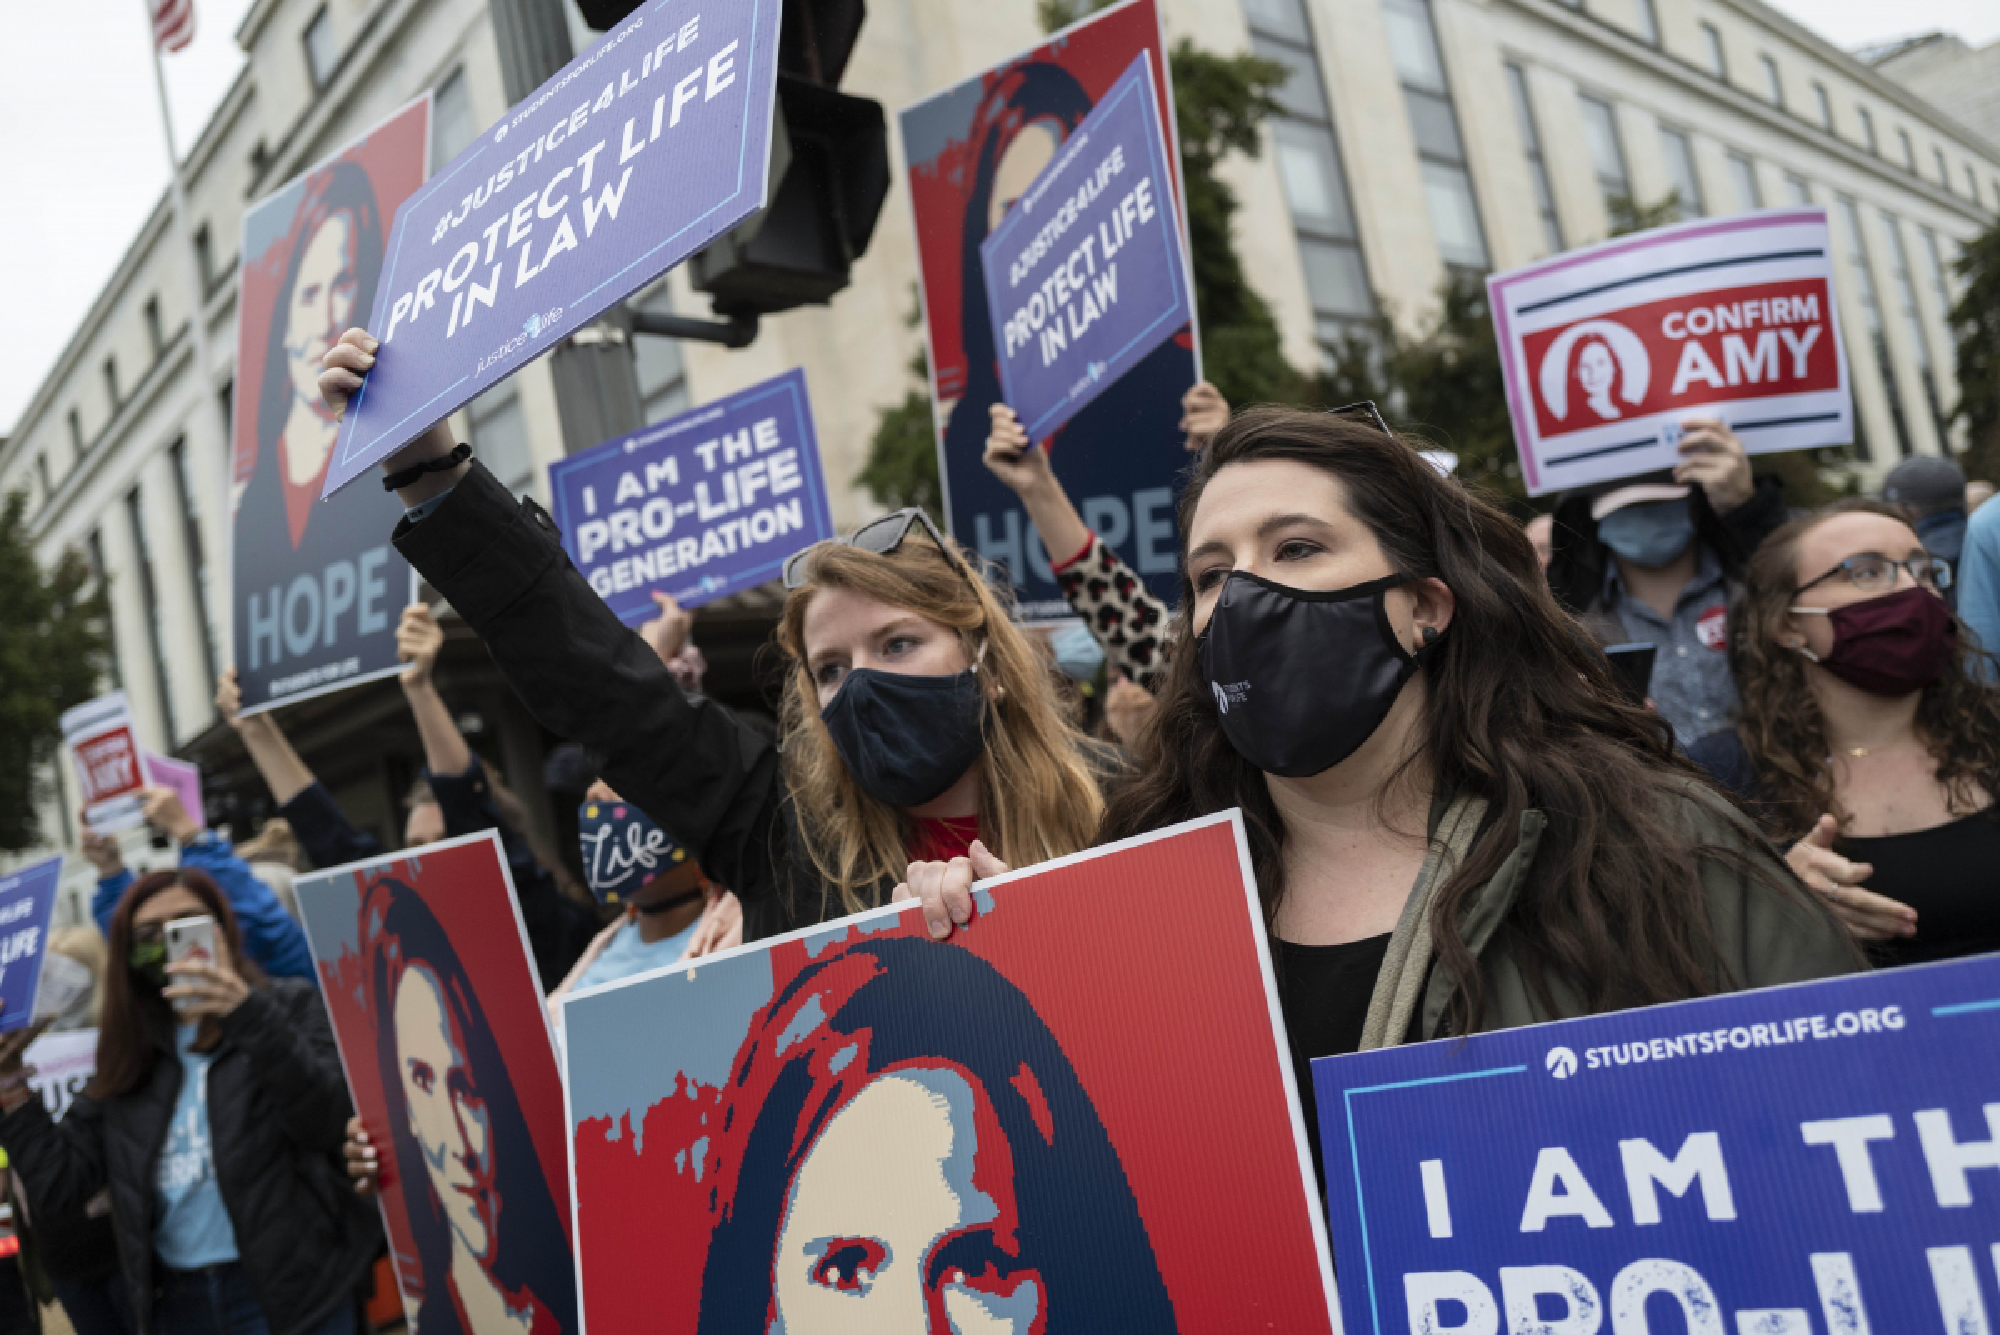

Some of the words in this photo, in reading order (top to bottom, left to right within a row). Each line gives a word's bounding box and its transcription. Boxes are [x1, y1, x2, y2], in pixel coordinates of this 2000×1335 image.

[512, 17, 643, 128] STUDENTSFORLIFE.ORG
[431, 13, 701, 246] #JUSTICE4LIFE
[384, 139, 607, 344] PROTECT
[618, 37, 739, 166] LIFE
[445, 262, 503, 339] IN
[514, 165, 633, 289] LAW
[1003, 233, 1096, 358] PROTECT
[1098, 176, 1156, 260] LIFE
[1040, 316, 1068, 367] IN
[1067, 262, 1118, 341] LAW
[1661, 293, 1820, 340] CONFIRM
[1670, 325, 1823, 396] AMY
[576, 447, 803, 563] PRO-LIFE
[582, 485, 597, 515] I
[614, 454, 679, 505] AM
[693, 416, 781, 471] THE
[586, 498, 803, 598] GENERATION
[248, 545, 389, 671] HOPE
[578, 821, 674, 892] Life
[1585, 1006, 1905, 1070] STUDENTSFORLIFE.ORG
[1419, 1158, 1453, 1239] I
[1519, 1131, 1738, 1233] AM
